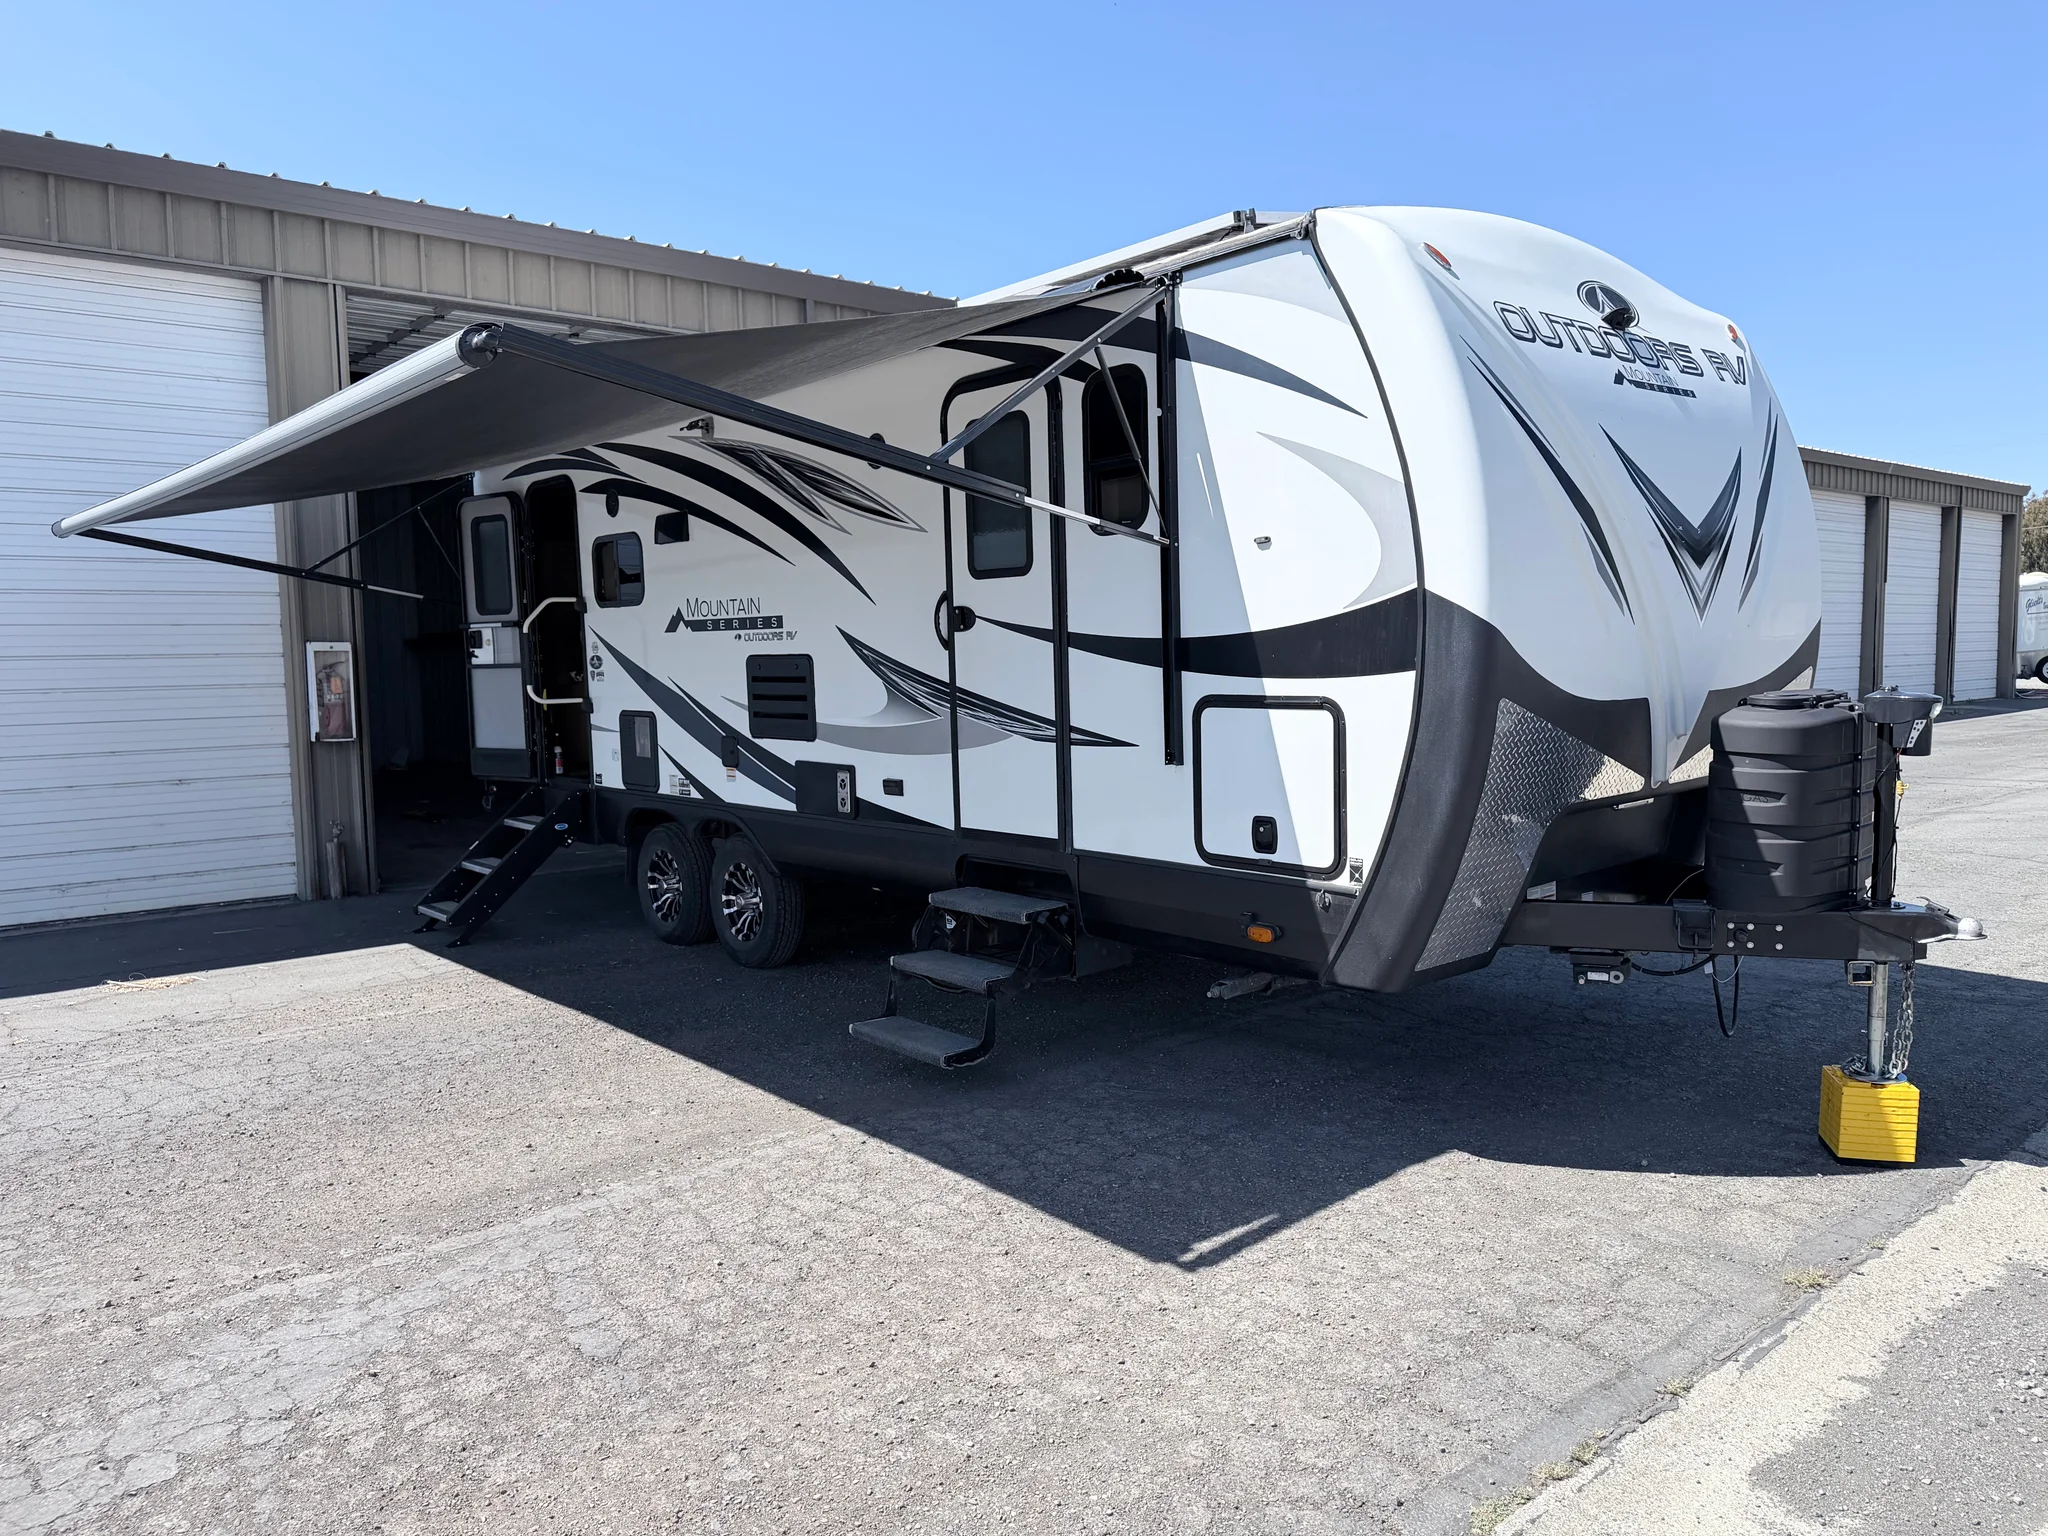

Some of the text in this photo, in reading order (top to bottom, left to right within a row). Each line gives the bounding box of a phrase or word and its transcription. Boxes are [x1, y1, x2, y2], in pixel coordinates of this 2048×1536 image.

[1493, 301, 1747, 385] OUTDOORS RV
[1622, 364, 1679, 387] MOUNTAIN
[1643, 382, 1695, 398] SERIES
[686, 597, 761, 618] MOUNTAIN
[706, 617, 778, 630] SERIES
[744, 630, 798, 642] OUTDOORS RV
